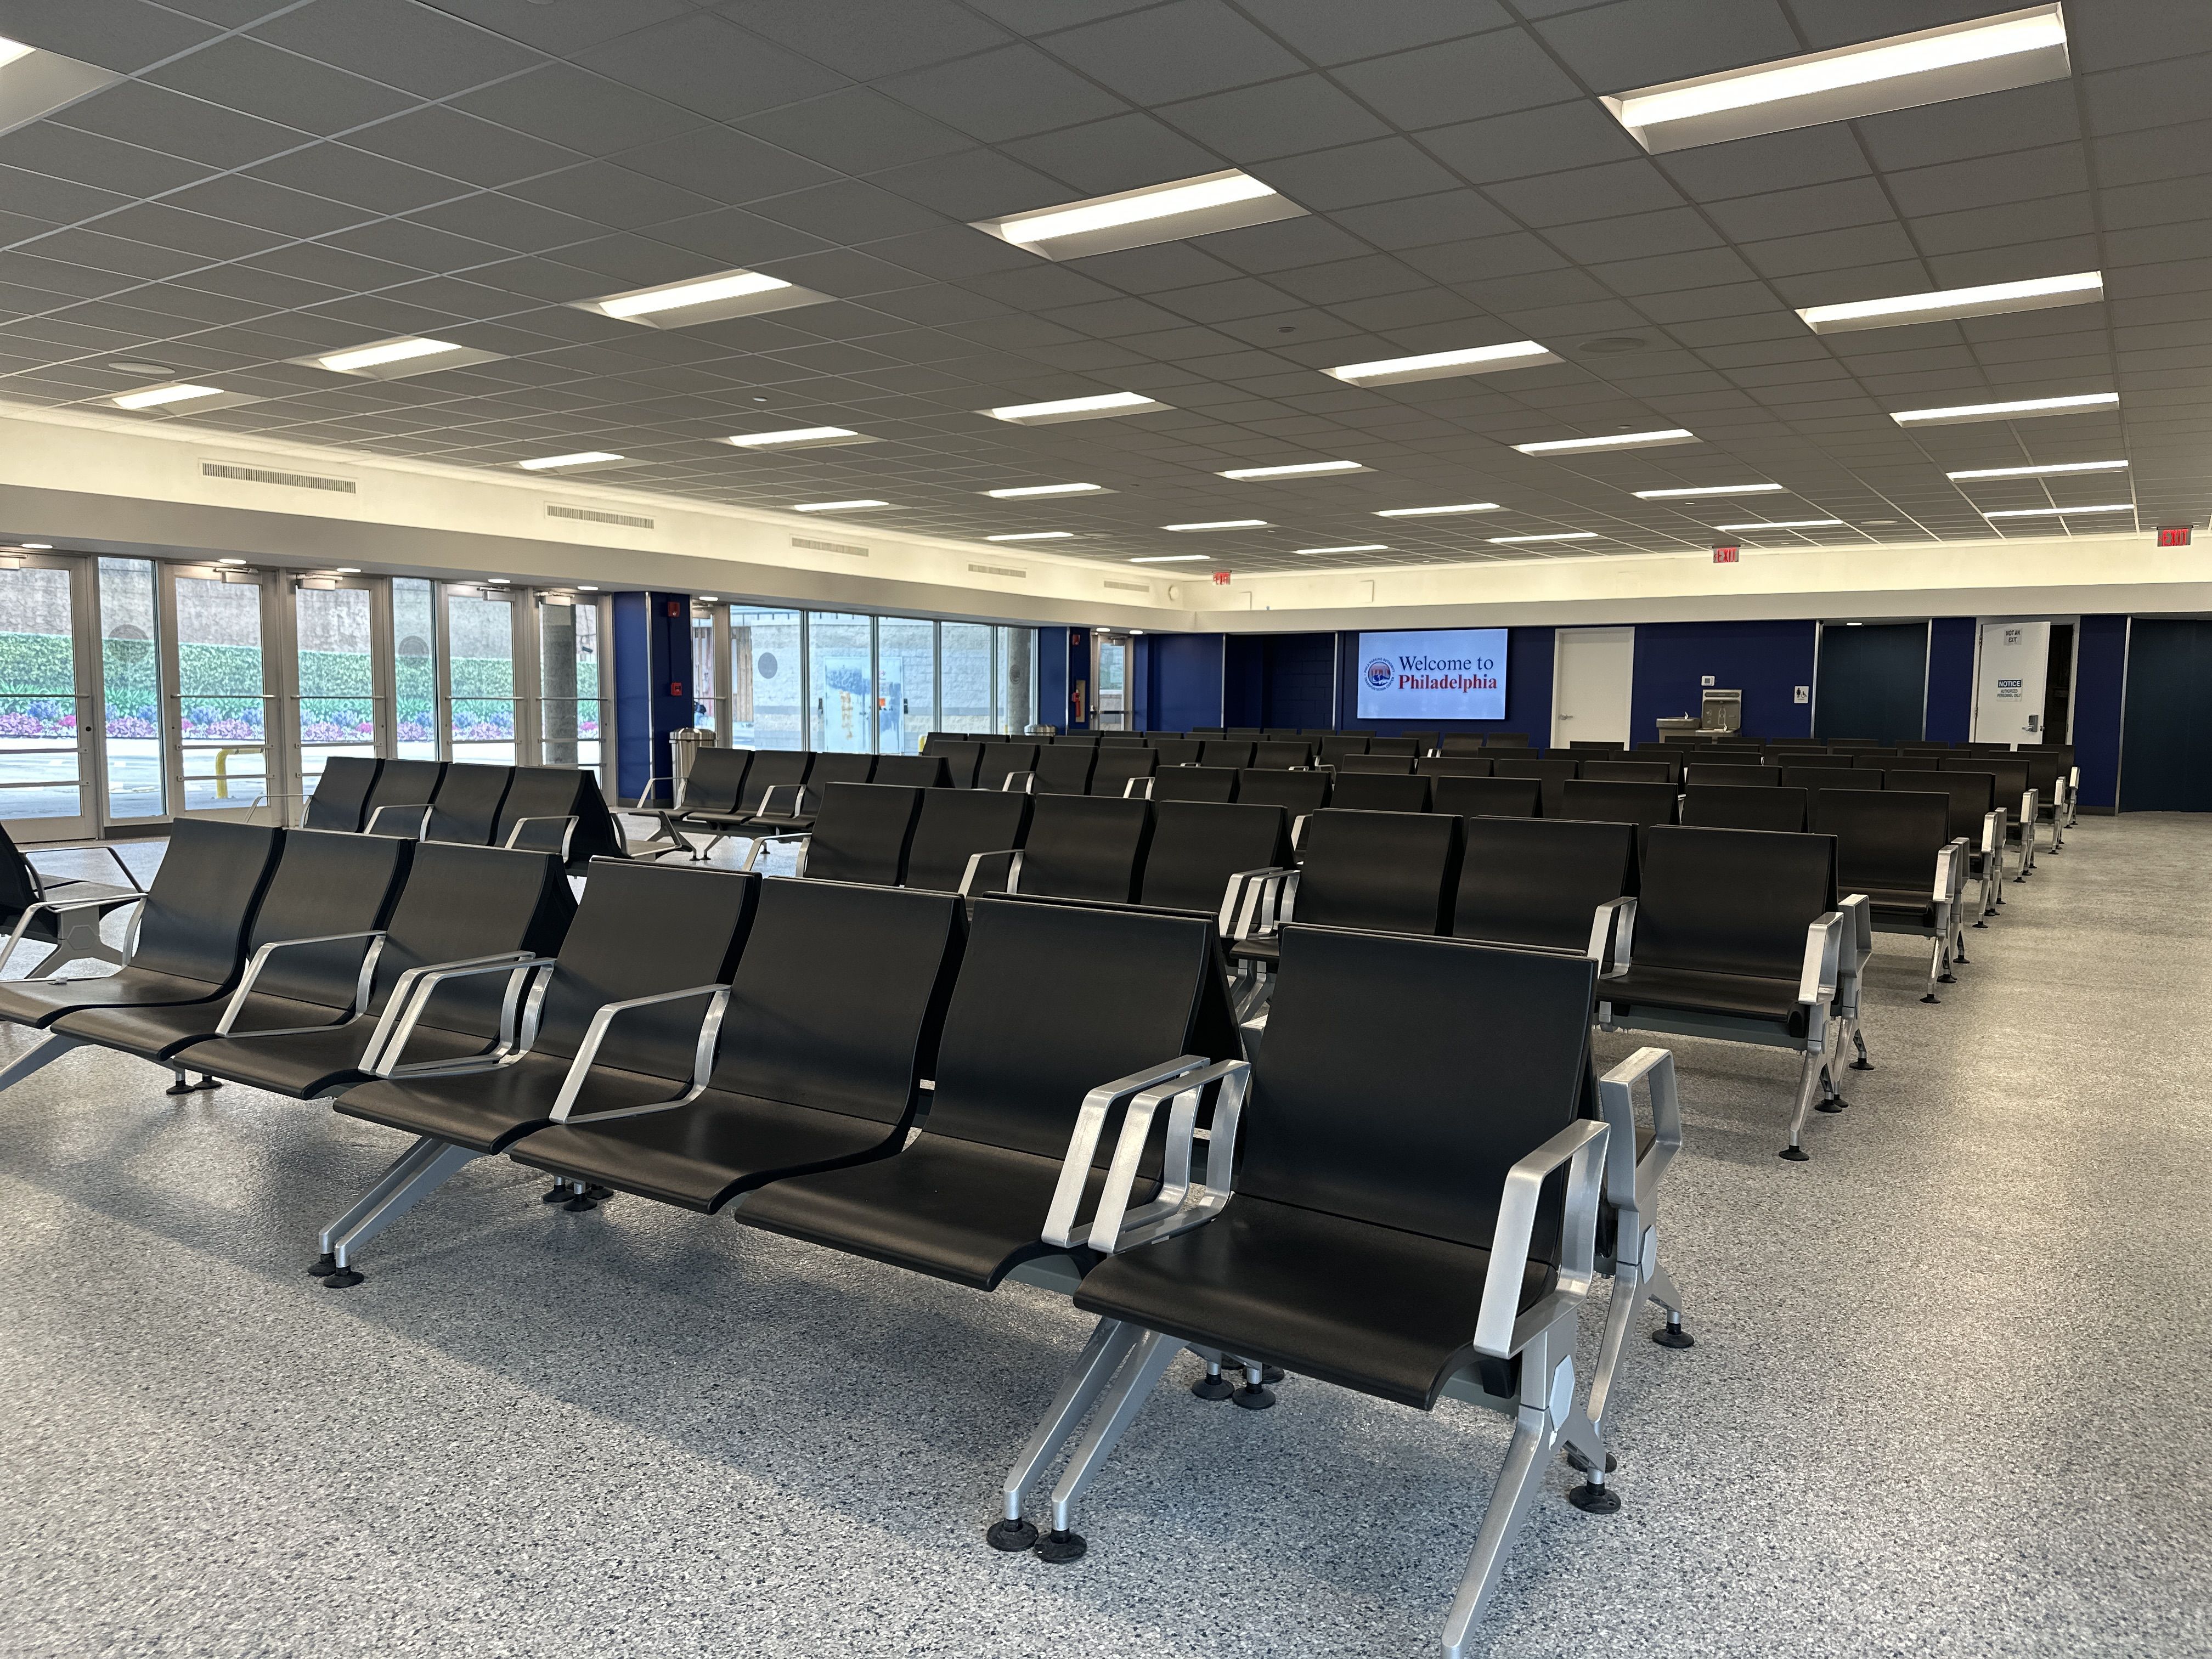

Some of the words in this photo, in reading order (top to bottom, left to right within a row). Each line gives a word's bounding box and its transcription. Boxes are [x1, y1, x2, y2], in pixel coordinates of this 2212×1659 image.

[2163, 529, 2188, 546] EXIT
[1718, 548, 1736, 562] EXIT
[1399, 656, 1471, 670] Welcome
[1477, 657, 1494, 670] to
[1398, 674, 1497, 693] Philadelphia
